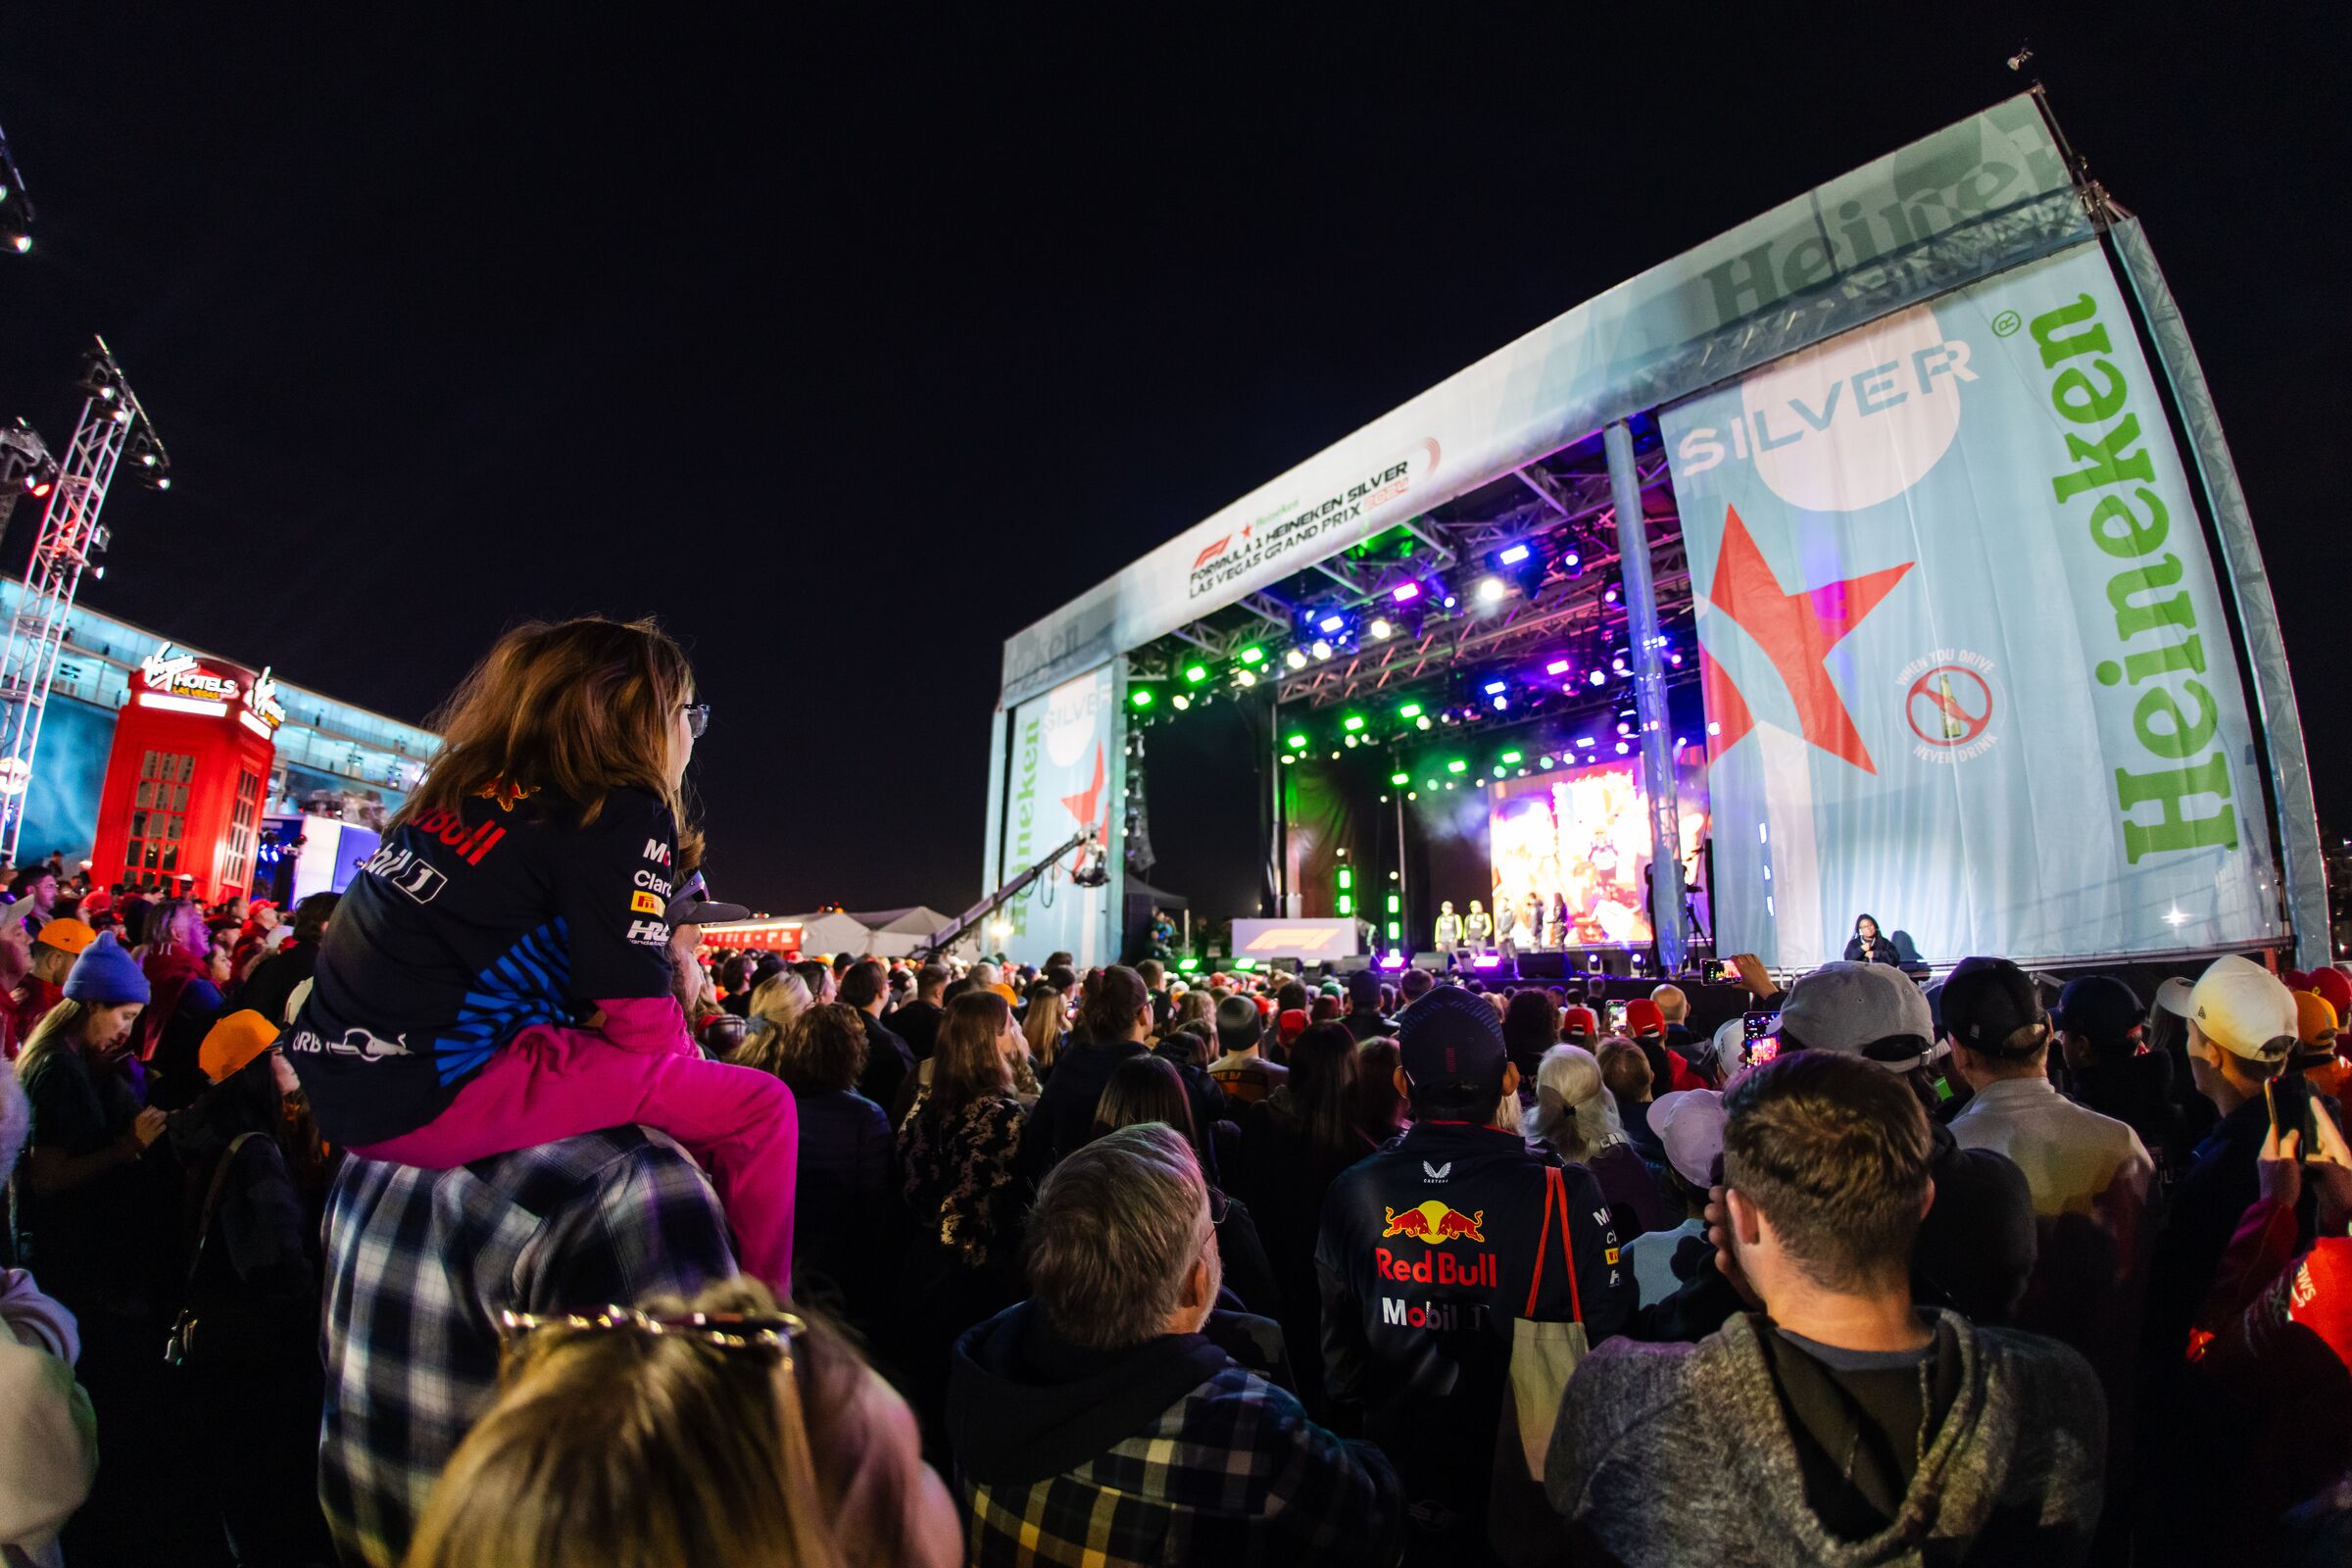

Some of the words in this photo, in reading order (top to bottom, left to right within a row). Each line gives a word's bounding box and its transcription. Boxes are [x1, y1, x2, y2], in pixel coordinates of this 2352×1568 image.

[1678, 339, 1980, 476] SILVER
[1190, 540, 1251, 584] FORMULA
[1254, 536, 1263, 549] 1
[1266, 493, 1344, 542] HEINEKEN
[1348, 461, 1408, 503] SILVER
[1190, 579, 1214, 599] LAS
[1216, 553, 1261, 585] VEGAS
[1265, 524, 1319, 560] GRAND
[1322, 503, 1362, 533] PRIX
[2030, 293, 2238, 864] Heineken
[173, 673, 236, 694] HOTELS
[1895, 657, 1929, 686] WHEN
[1929, 649, 1955, 663] YOU
[1958, 649, 1995, 674] DRIVE
[1913, 744, 1954, 763] NEVER
[1958, 732, 1998, 762] DRINK
[363, 843, 413, 877] bil
[1376, 1247, 1433, 1284] Red
[1438, 1251, 1496, 1288] Bull
[1382, 1297, 1458, 1333] Mobil
